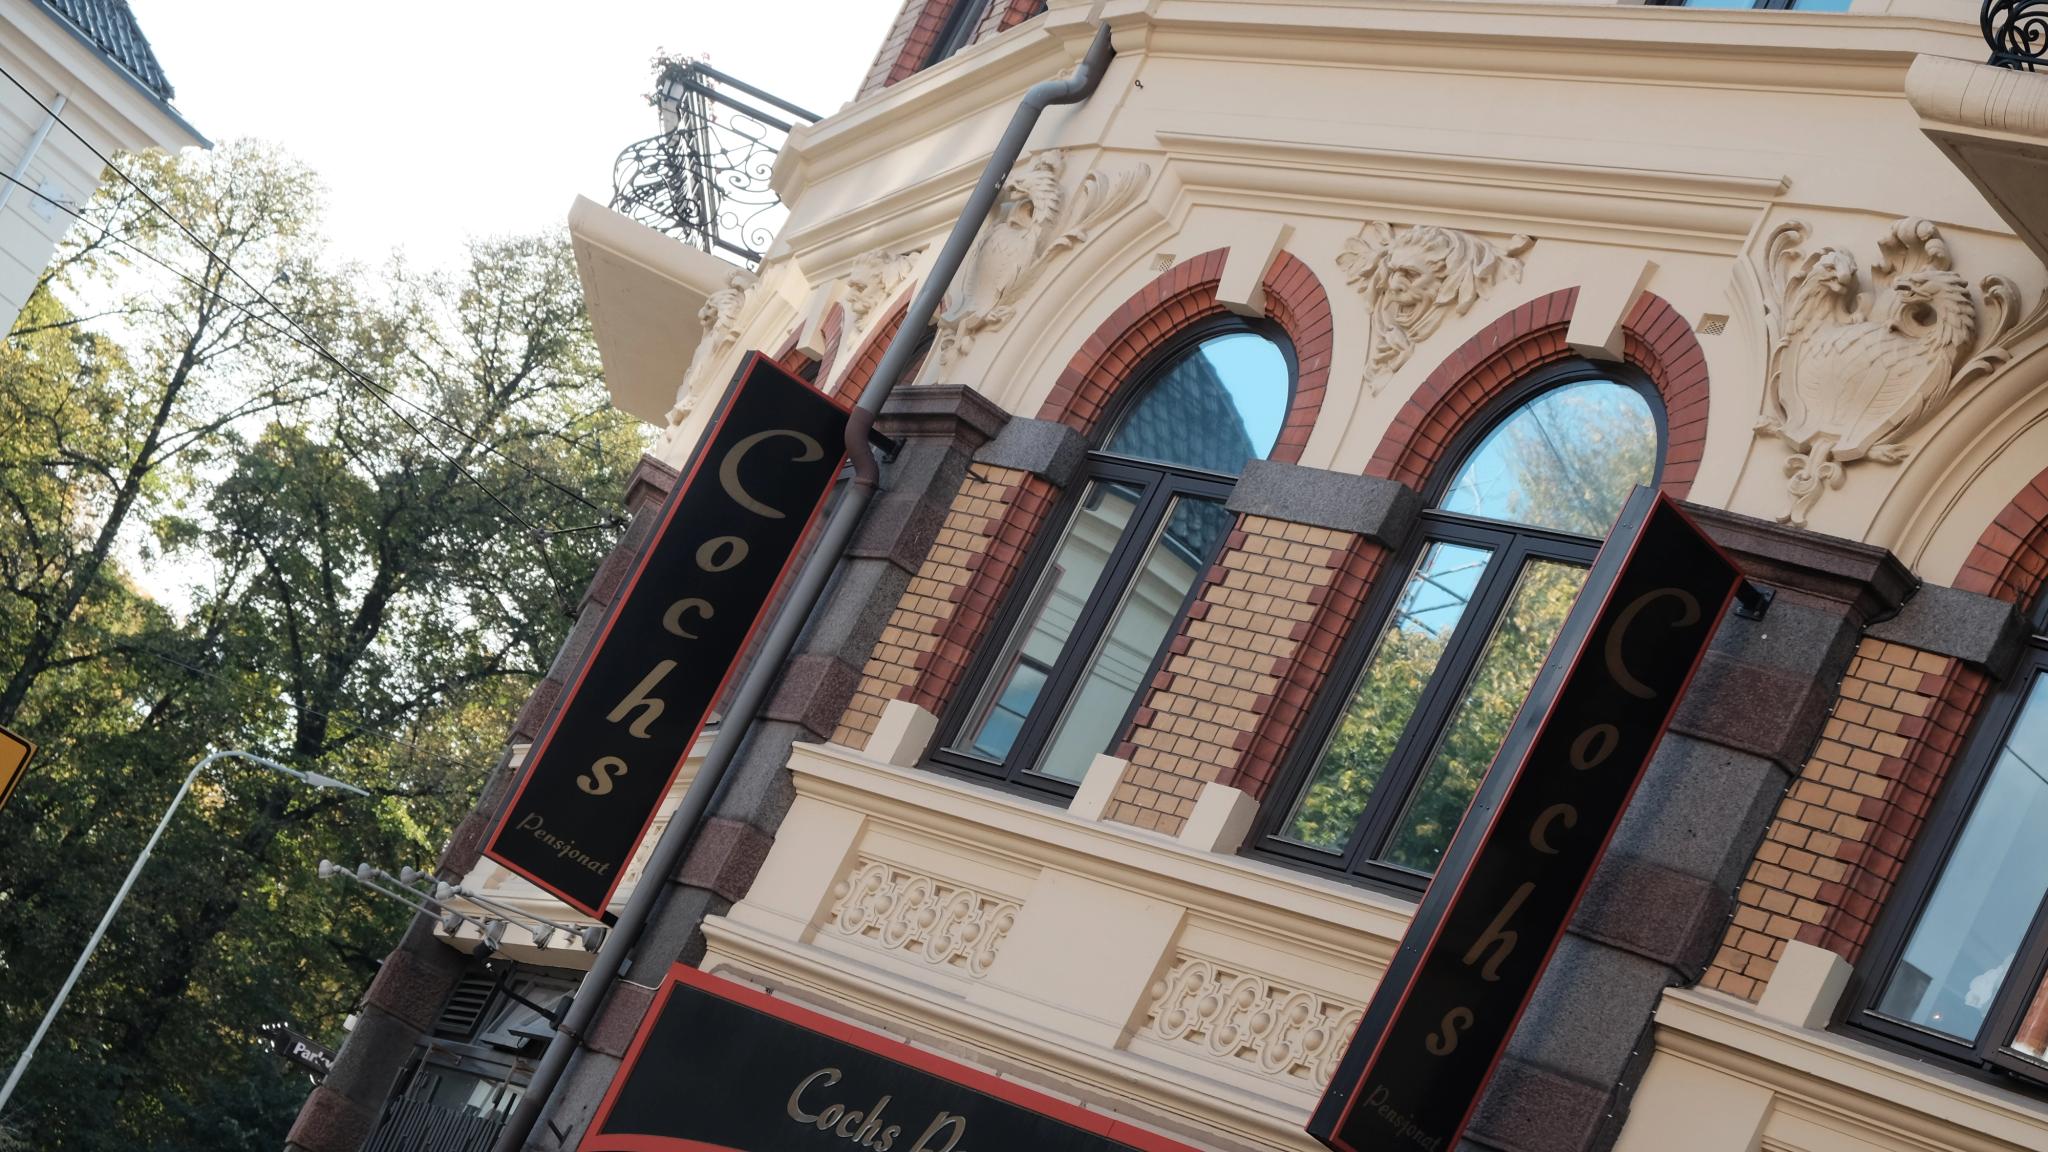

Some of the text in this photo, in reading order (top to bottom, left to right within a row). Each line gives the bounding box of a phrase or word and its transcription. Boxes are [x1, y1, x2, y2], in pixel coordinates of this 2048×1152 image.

[575, 429, 825, 796] Cochs
[516, 812, 610, 875] Pensjonat
[1425, 587, 1699, 1057] Cochs
[787, 1067, 901, 1152] Cochs
[1363, 1083, 1442, 1152] Pensjonat
